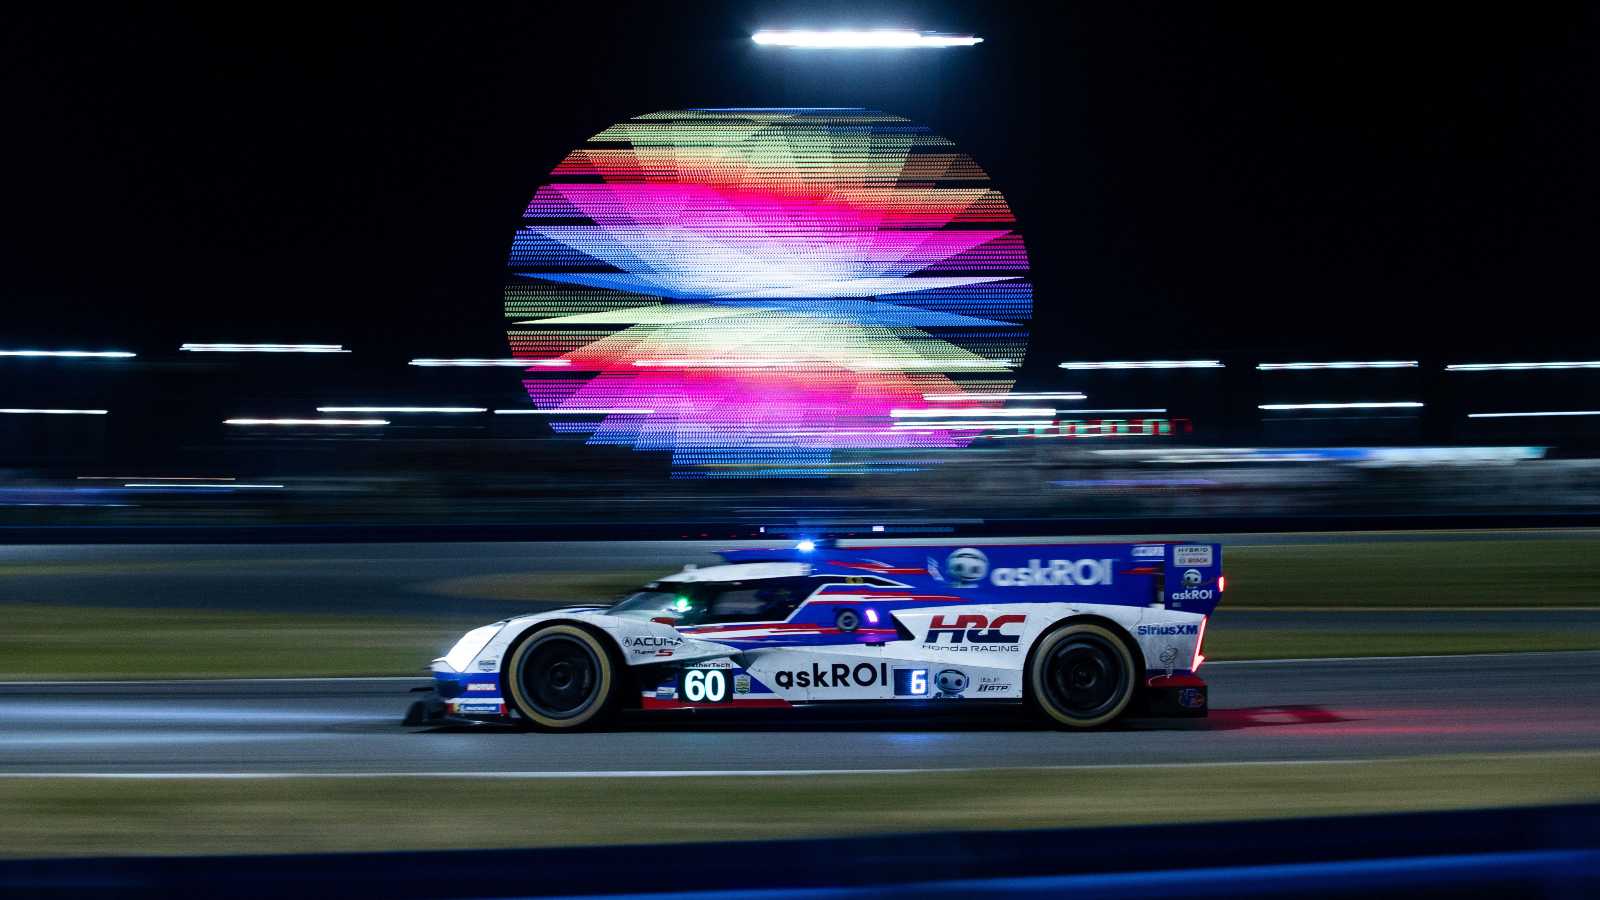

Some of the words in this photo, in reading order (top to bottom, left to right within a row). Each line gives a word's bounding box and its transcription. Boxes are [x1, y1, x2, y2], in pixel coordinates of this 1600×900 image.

[991, 559, 1113, 586] askROI
[1172, 589, 1213, 600] askROI
[924, 614, 1027, 644] HRC
[1137, 624, 1198, 636] SiriusXM
[633, 637, 683, 646] ACURA
[921, 644, 968, 652] Honda
[684, 669, 726, 702] 60
[774, 662, 888, 690] askROI
[910, 670, 926, 694] 6
